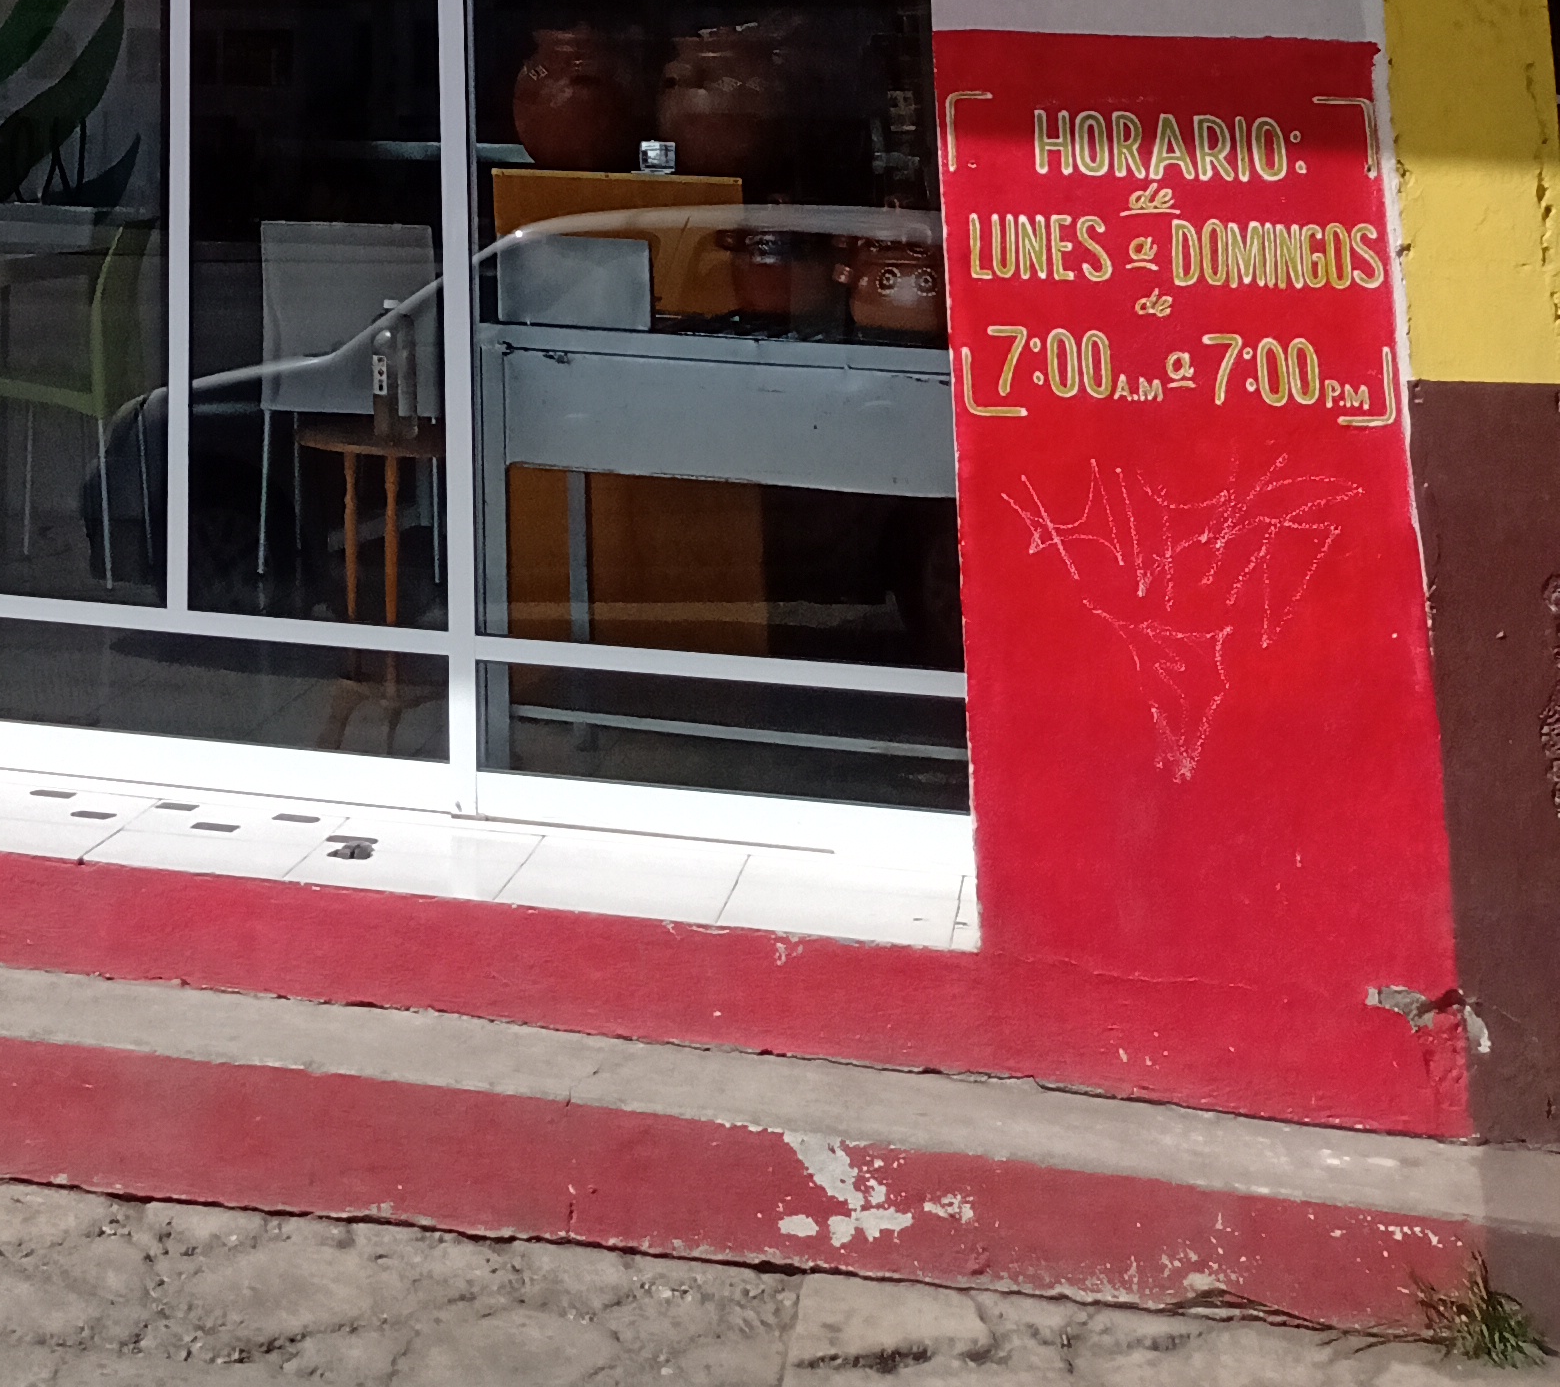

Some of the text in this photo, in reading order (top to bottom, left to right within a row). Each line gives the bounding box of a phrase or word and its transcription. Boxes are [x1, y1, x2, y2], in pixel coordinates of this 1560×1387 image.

[1033, 109, 1308, 182] HORARIO:
[1129, 183, 1174, 210] de
[969, 213, 1384, 290] LUNES a DOMINGOS
[1135, 288, 1173, 317] de
[988, 326, 1112, 398] 7:00
[1166, 349, 1196, 378] a
[1203, 333, 1320, 406] 7:00
